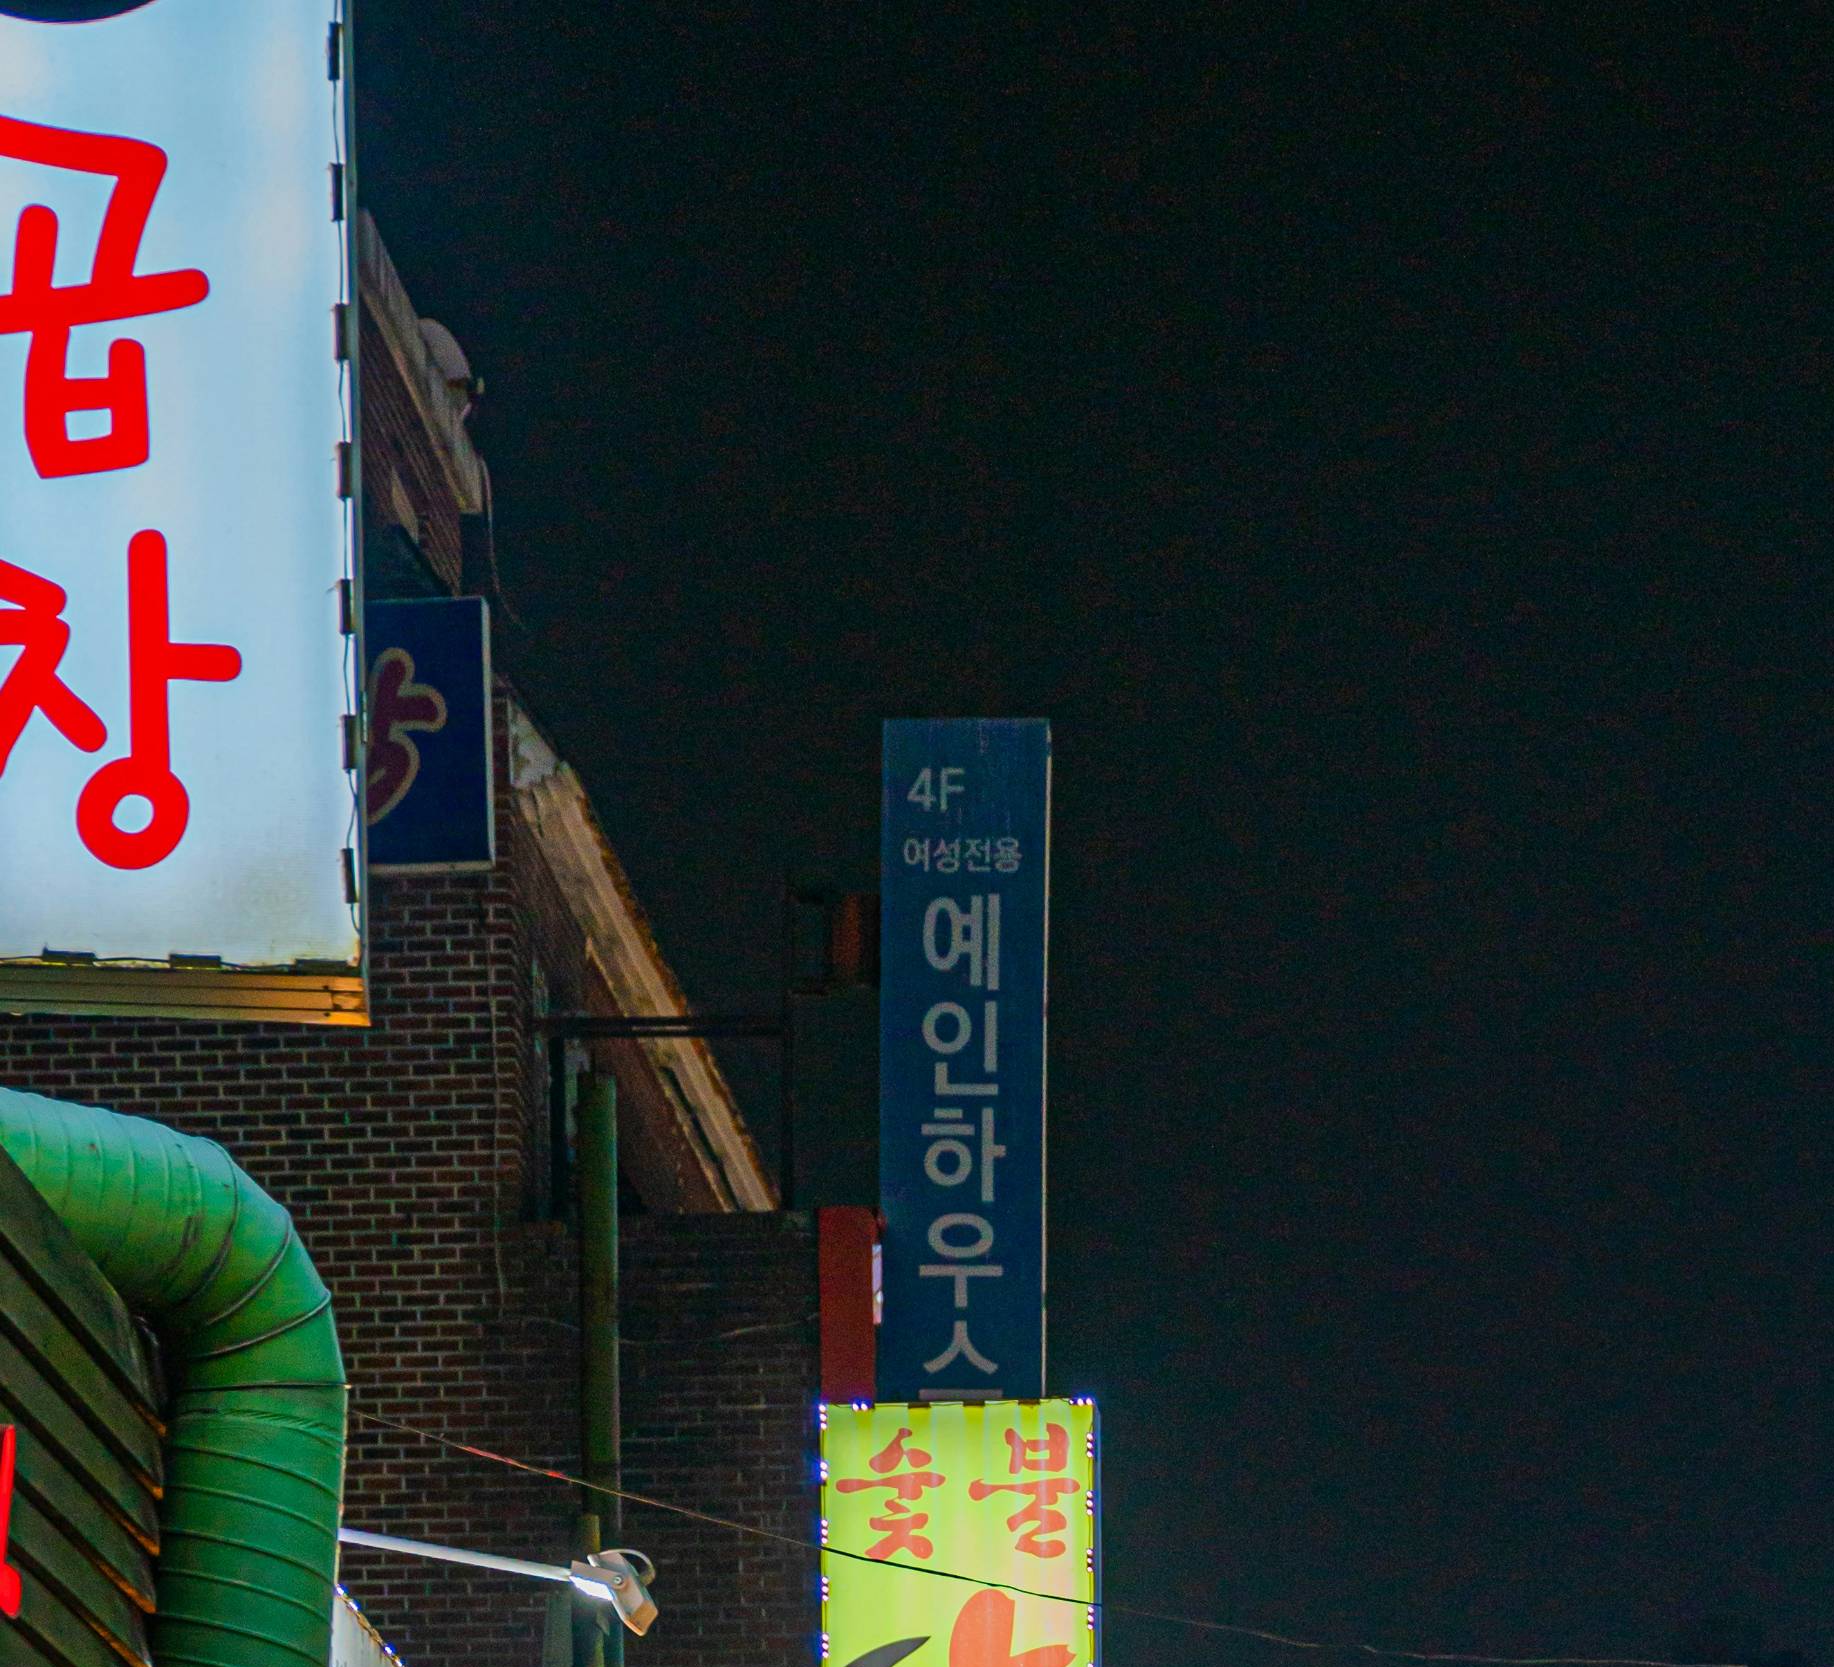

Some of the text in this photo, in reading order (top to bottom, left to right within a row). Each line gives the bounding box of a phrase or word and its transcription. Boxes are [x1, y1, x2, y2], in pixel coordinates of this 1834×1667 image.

[907, 768, 965, 811] 4F
[904, 837, 1022, 872] 여성전용
[919, 894, 1006, 1400] 예인하우스
[836, 1422, 1080, 1560] 숯불
